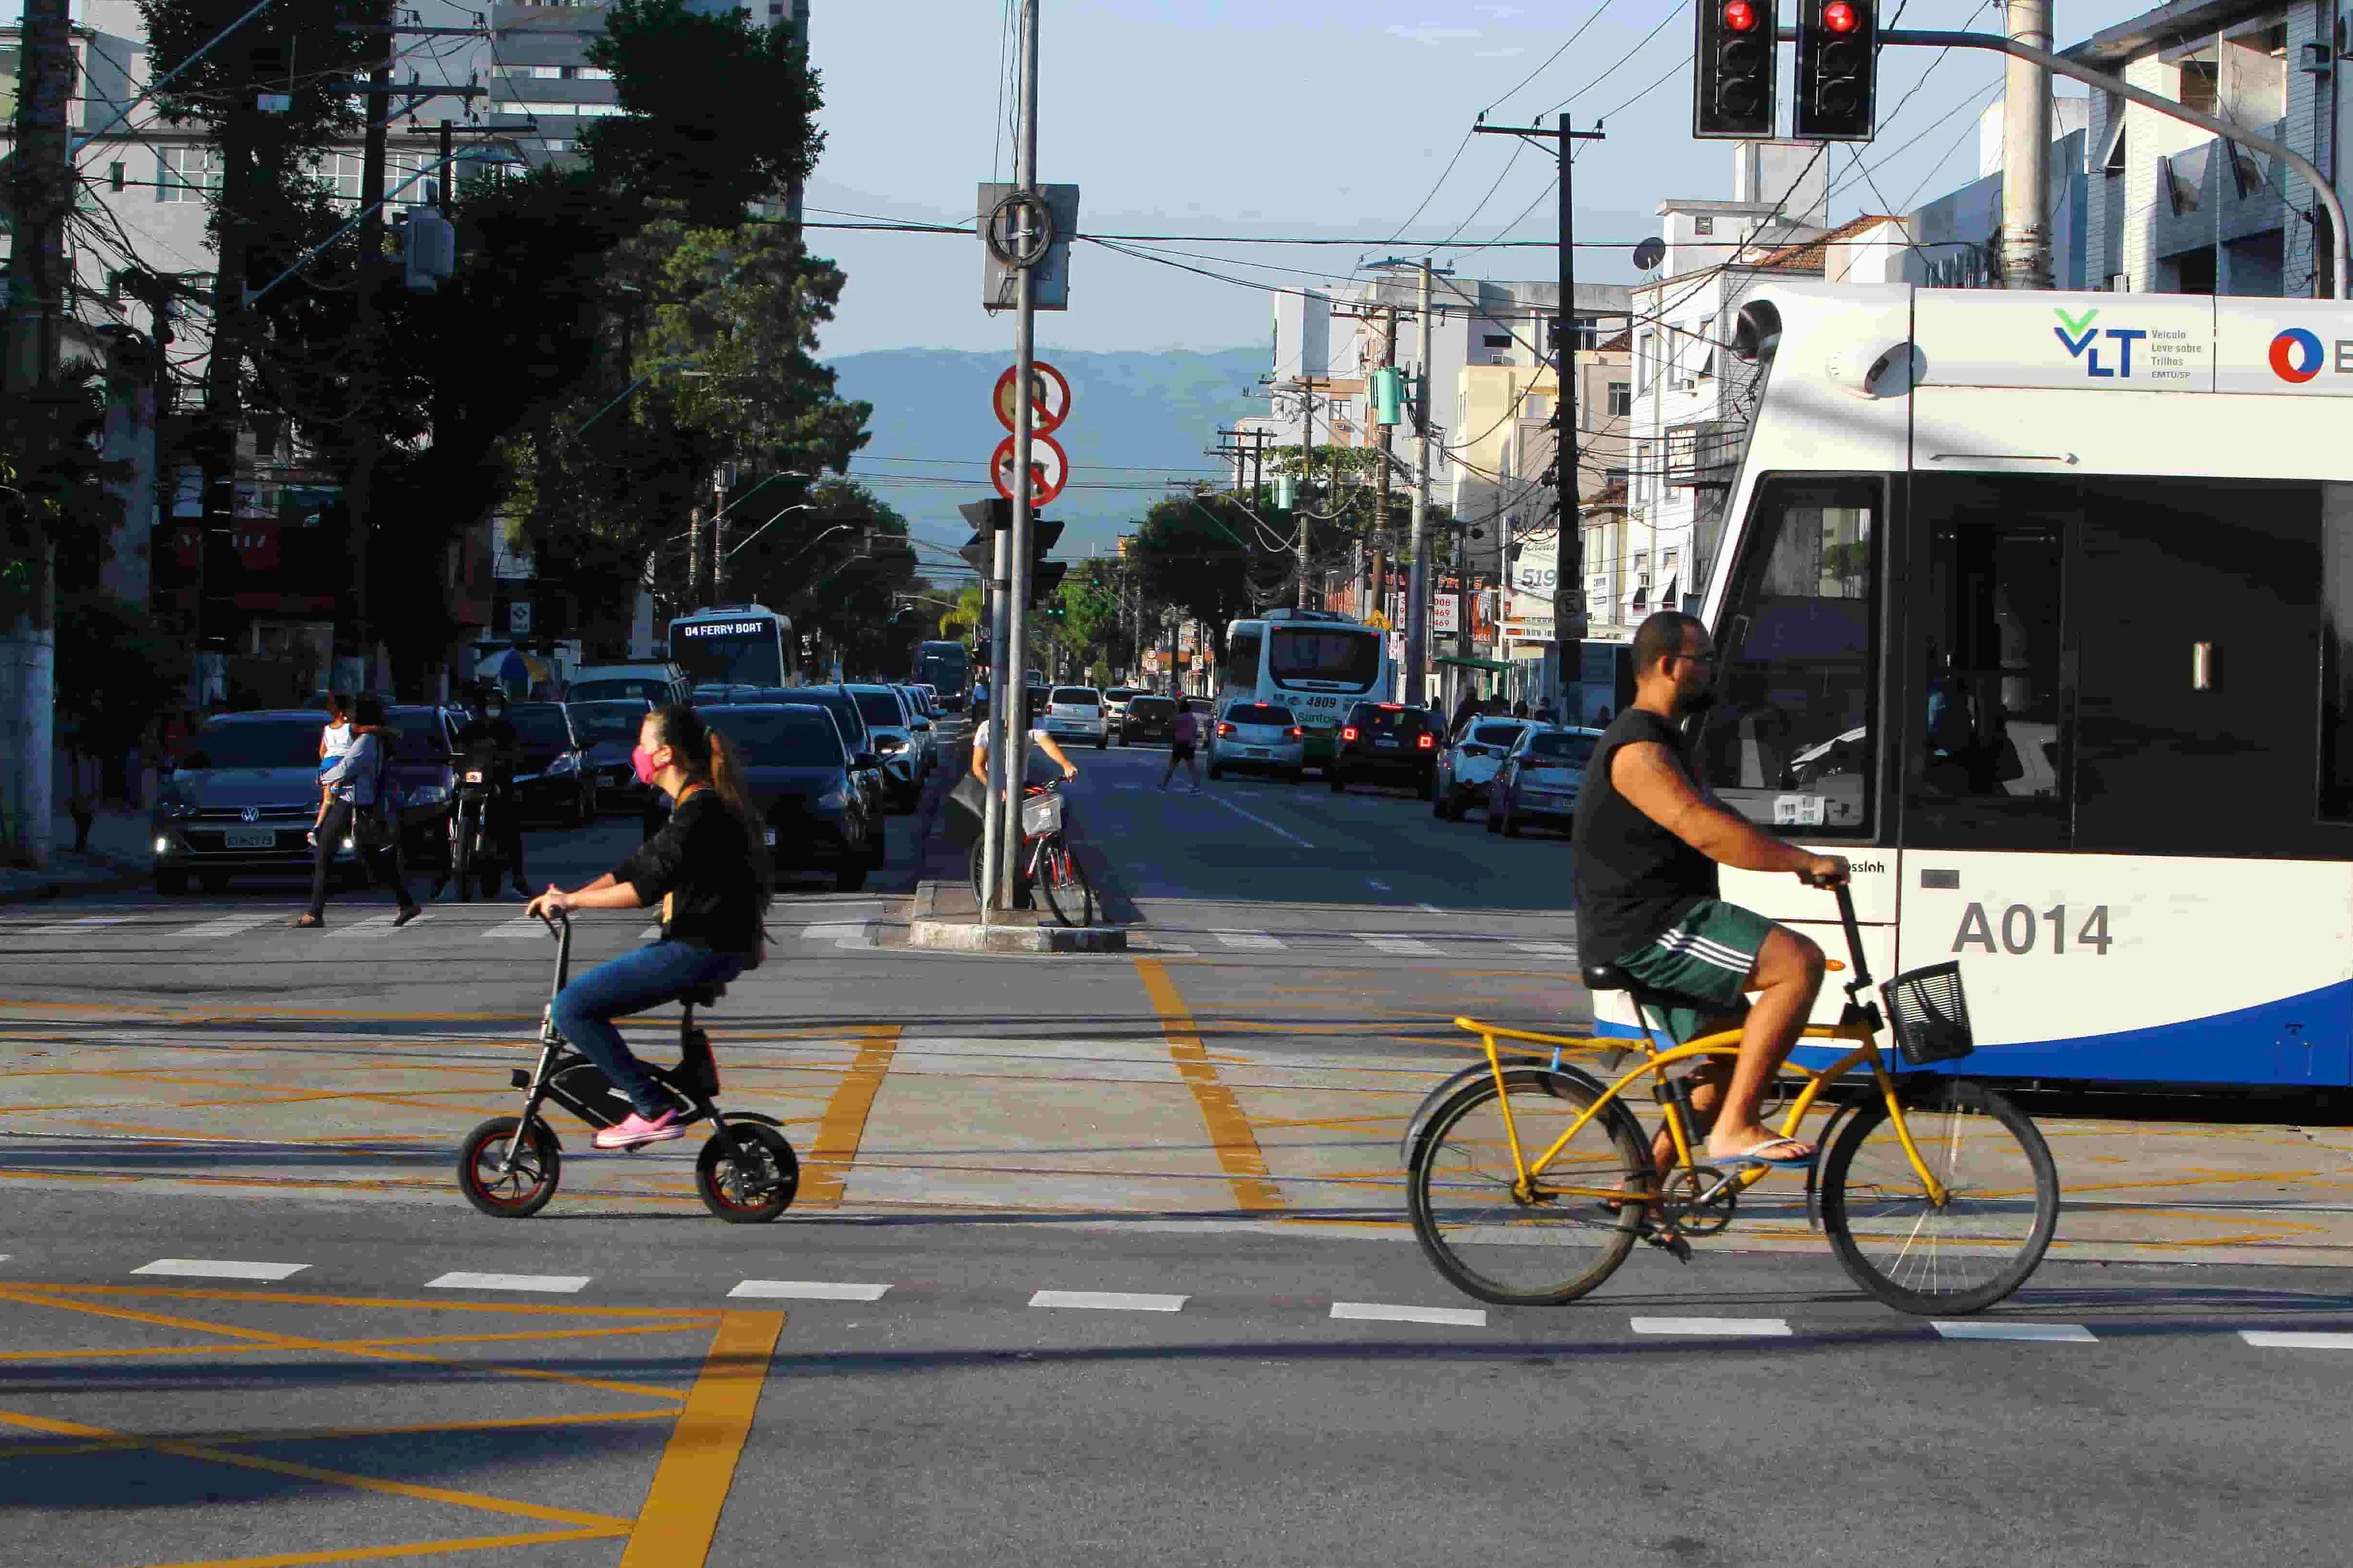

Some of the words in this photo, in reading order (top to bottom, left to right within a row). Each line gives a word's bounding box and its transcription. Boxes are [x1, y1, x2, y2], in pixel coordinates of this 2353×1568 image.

[2152, 343, 2174, 352] Leve
[2176, 343, 2202, 353] sobre
[700, 624, 733, 636] FERRY
[736, 622, 763, 633] BOAT
[1951, 902, 2113, 955] A014
